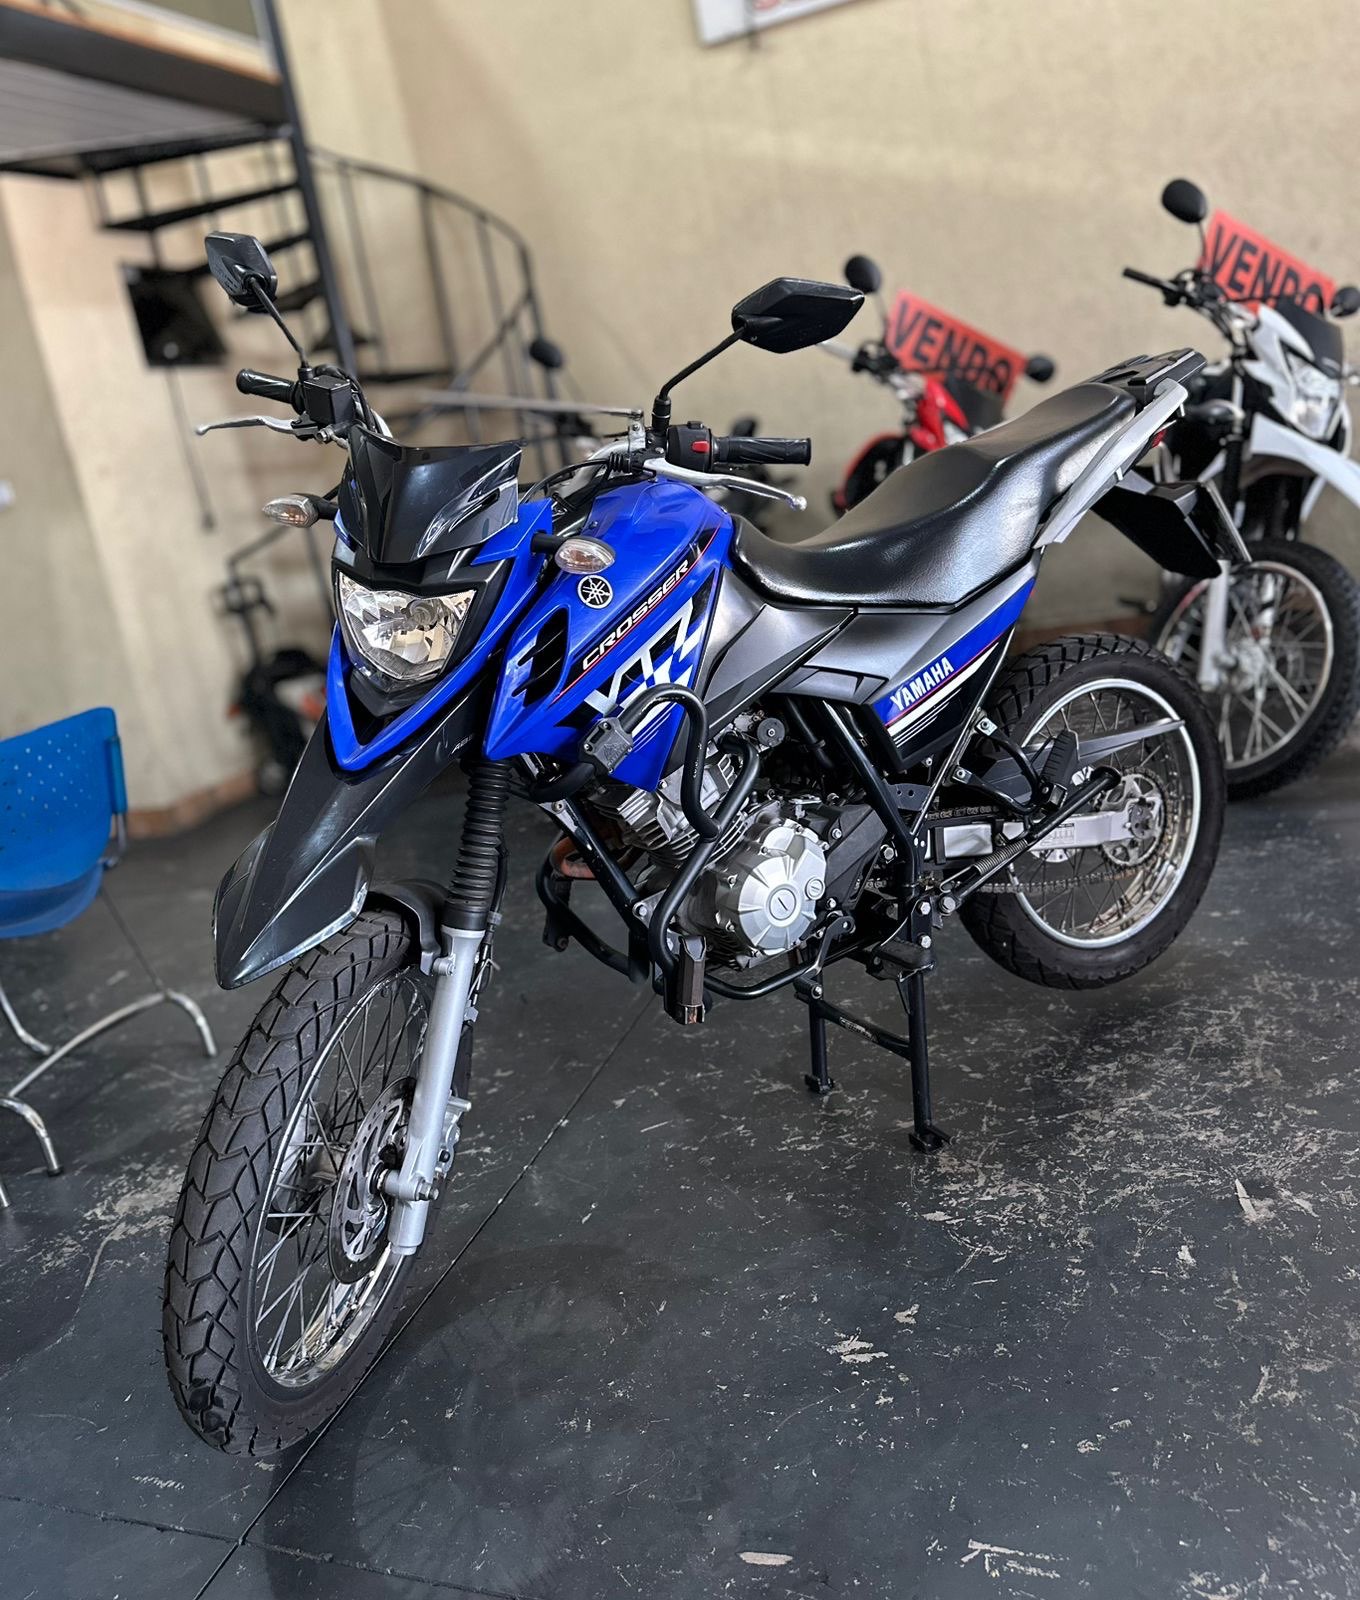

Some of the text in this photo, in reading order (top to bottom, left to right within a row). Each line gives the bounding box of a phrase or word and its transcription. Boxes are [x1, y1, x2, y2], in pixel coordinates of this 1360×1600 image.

[1211, 224, 1324, 317] VENDO
[895, 300, 1011, 392] VENDO
[583, 559, 688, 670] CROSSER
[889, 656, 955, 711] YAMAHA
